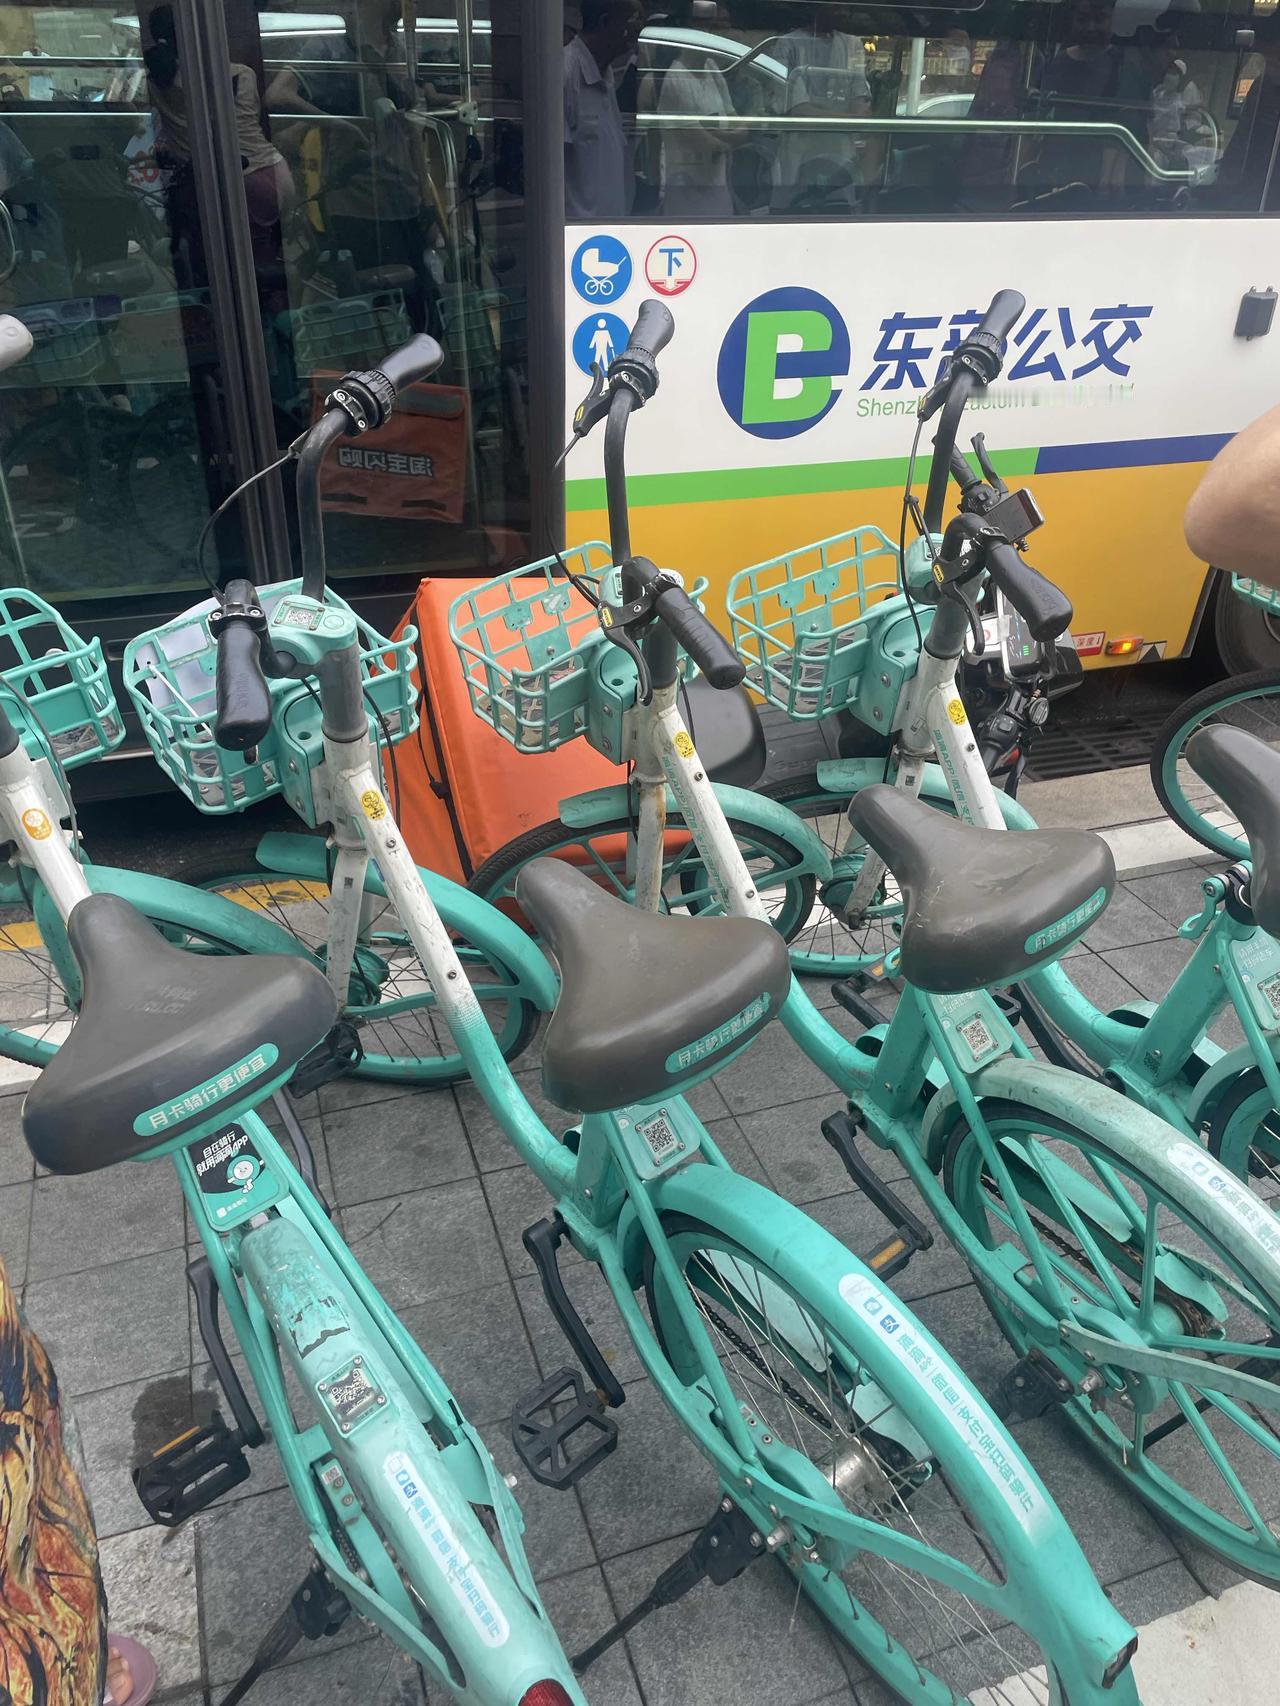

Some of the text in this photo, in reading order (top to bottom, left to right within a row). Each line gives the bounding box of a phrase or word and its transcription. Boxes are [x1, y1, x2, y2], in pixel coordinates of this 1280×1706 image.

[659, 248, 684, 276] 下
[149, 1053, 267, 1129] 月卡骑行更便宜
[202, 1131, 237, 1158] 自在骑行
